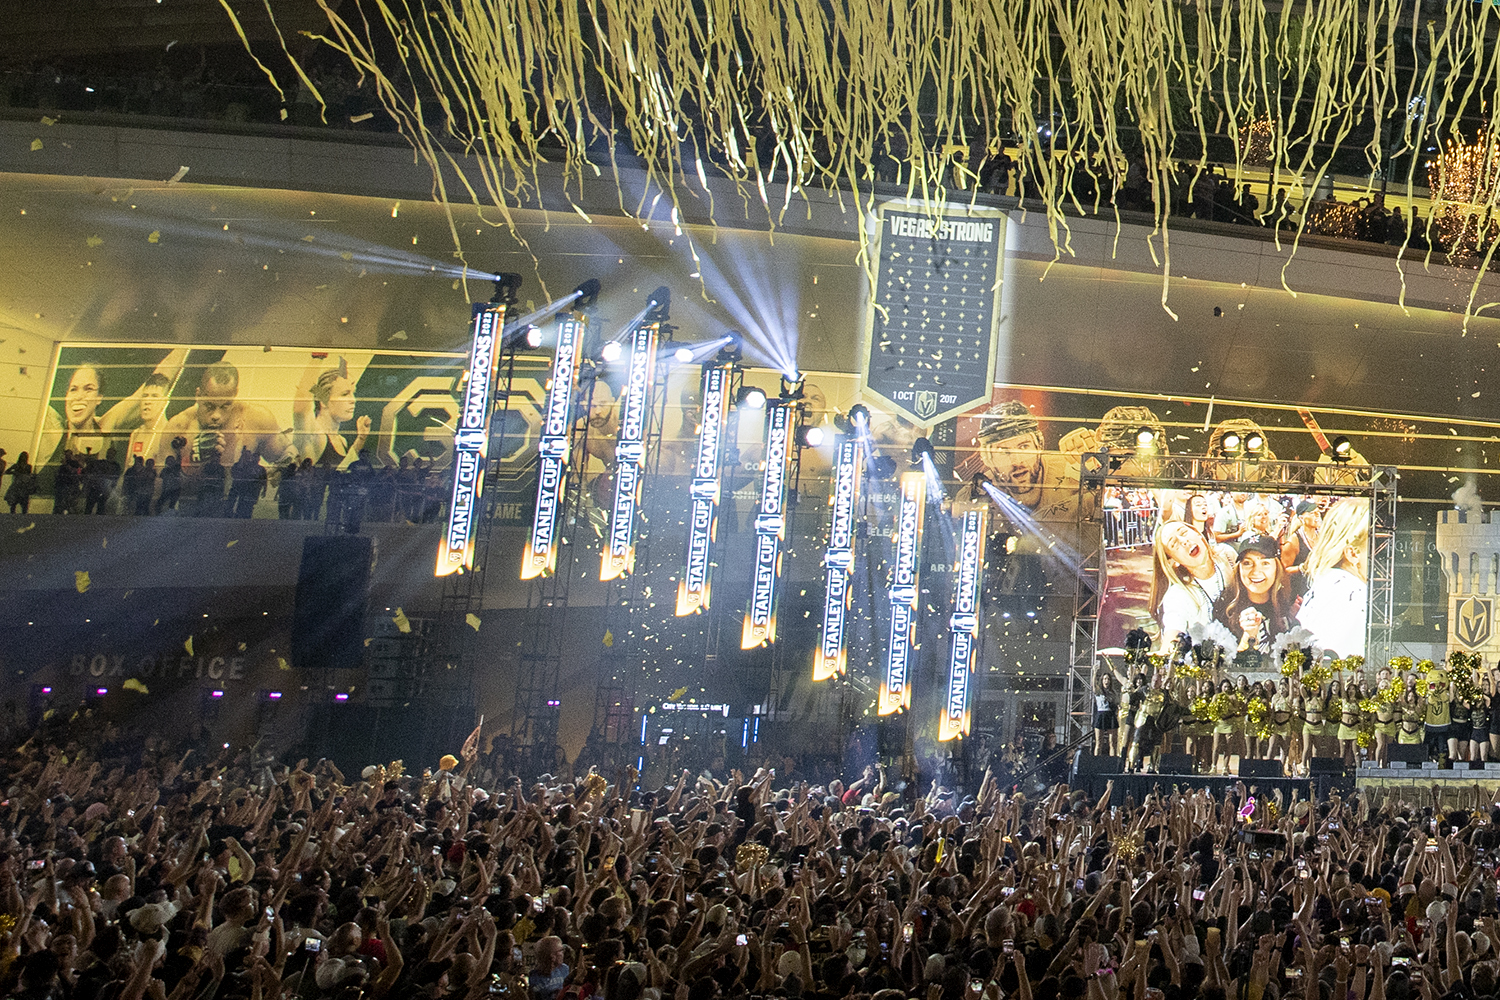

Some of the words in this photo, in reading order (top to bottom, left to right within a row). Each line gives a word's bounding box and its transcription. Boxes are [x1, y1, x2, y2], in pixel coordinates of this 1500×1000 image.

[891, 216, 934, 238] VEGAS
[938, 221, 993, 243] STRONG
[481, 313, 492, 334] 2023
[563, 323, 573, 343] 2023
[639, 330, 647, 350] 2023
[467, 336, 492, 428] CHAMPIONS
[550, 345, 573, 435] CHAMPIONS
[711, 370, 719, 390] 2023
[626, 352, 647, 440] CHAMPIONS
[893, 391, 897, 399] 1
[898, 391, 915, 401] OCT
[940, 394, 957, 404] 2017
[776, 408, 784, 428] 2023
[700, 392, 720, 477] CHAMPIONS
[461, 452, 477, 483] CUP
[844, 443, 852, 462] 2023
[543, 460, 558, 490] CUP
[620, 465, 635, 495] CUP
[765, 429, 785, 513] CHAMPIONS
[451, 485, 472, 549] STANLEY
[695, 501, 709, 530] CUP
[834, 463, 853, 547] CHAMPIONS
[535, 492, 554, 554] STANLEY
[614, 495, 631, 556] STANLEY
[968, 512, 976, 530] 2023
[760, 535, 774, 563] CUP
[900, 502, 915, 584] CHAMPIONS
[689, 532, 706, 591] STANLEY
[960, 532, 976, 612] CHAMPIONS
[754, 566, 771, 625] STANLEY
[831, 568, 842, 596] CUP
[825, 599, 841, 658] STANLEY
[895, 605, 907, 632] CUP
[956, 633, 968, 659] CUP
[70, 653, 126, 677] BOX
[139, 655, 247, 680] OFFICE
[890, 634, 904, 692] STANLEY
[951, 661, 964, 718] STANLEY
